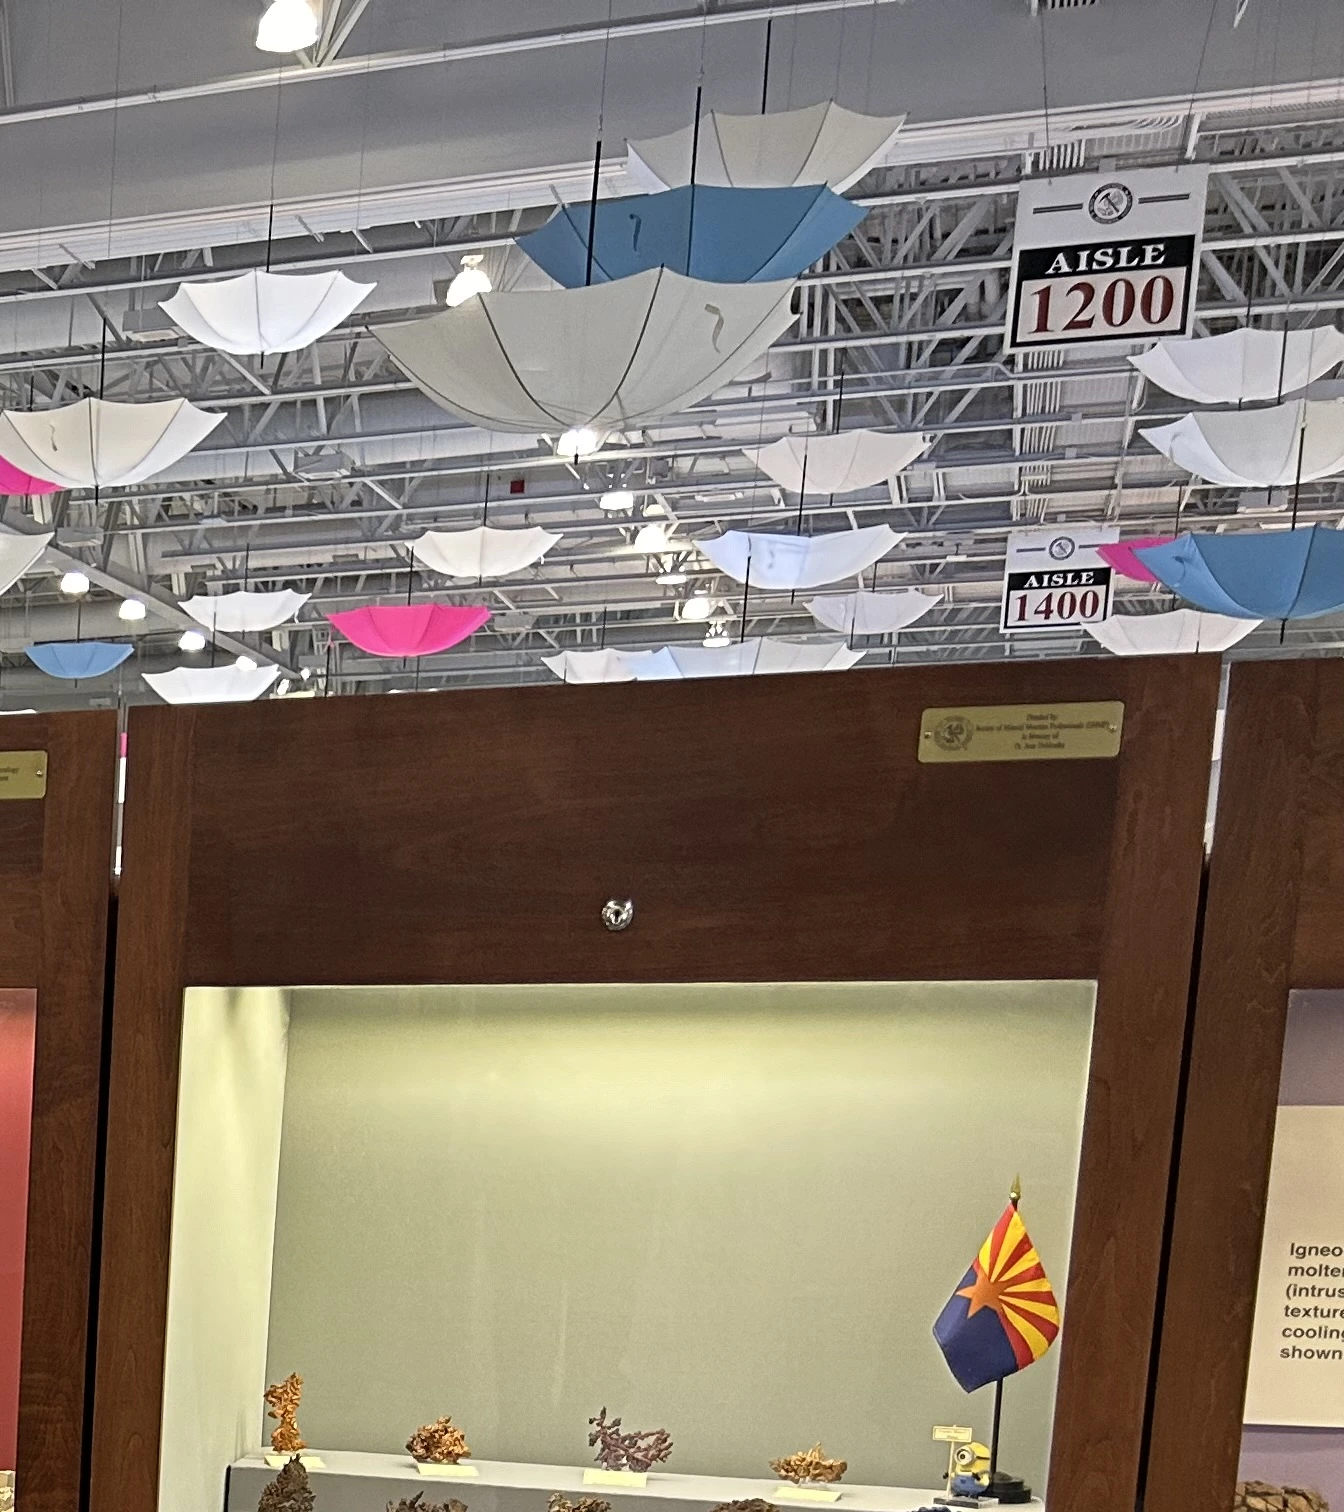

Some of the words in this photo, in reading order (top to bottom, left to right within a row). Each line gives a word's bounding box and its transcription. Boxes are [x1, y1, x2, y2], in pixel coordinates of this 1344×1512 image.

[1045, 243, 1166, 275] AISLE
[1027, 275, 1174, 334] 1200
[1023, 571, 1095, 588] AISLE
[1015, 589, 1100, 621] 1400
[1290, 1243, 1344, 1259] Igneo
[1288, 1264, 1344, 1278] molte
[1281, 1326, 1344, 1342] coolin
[1280, 1345, 1343, 1360] shown
